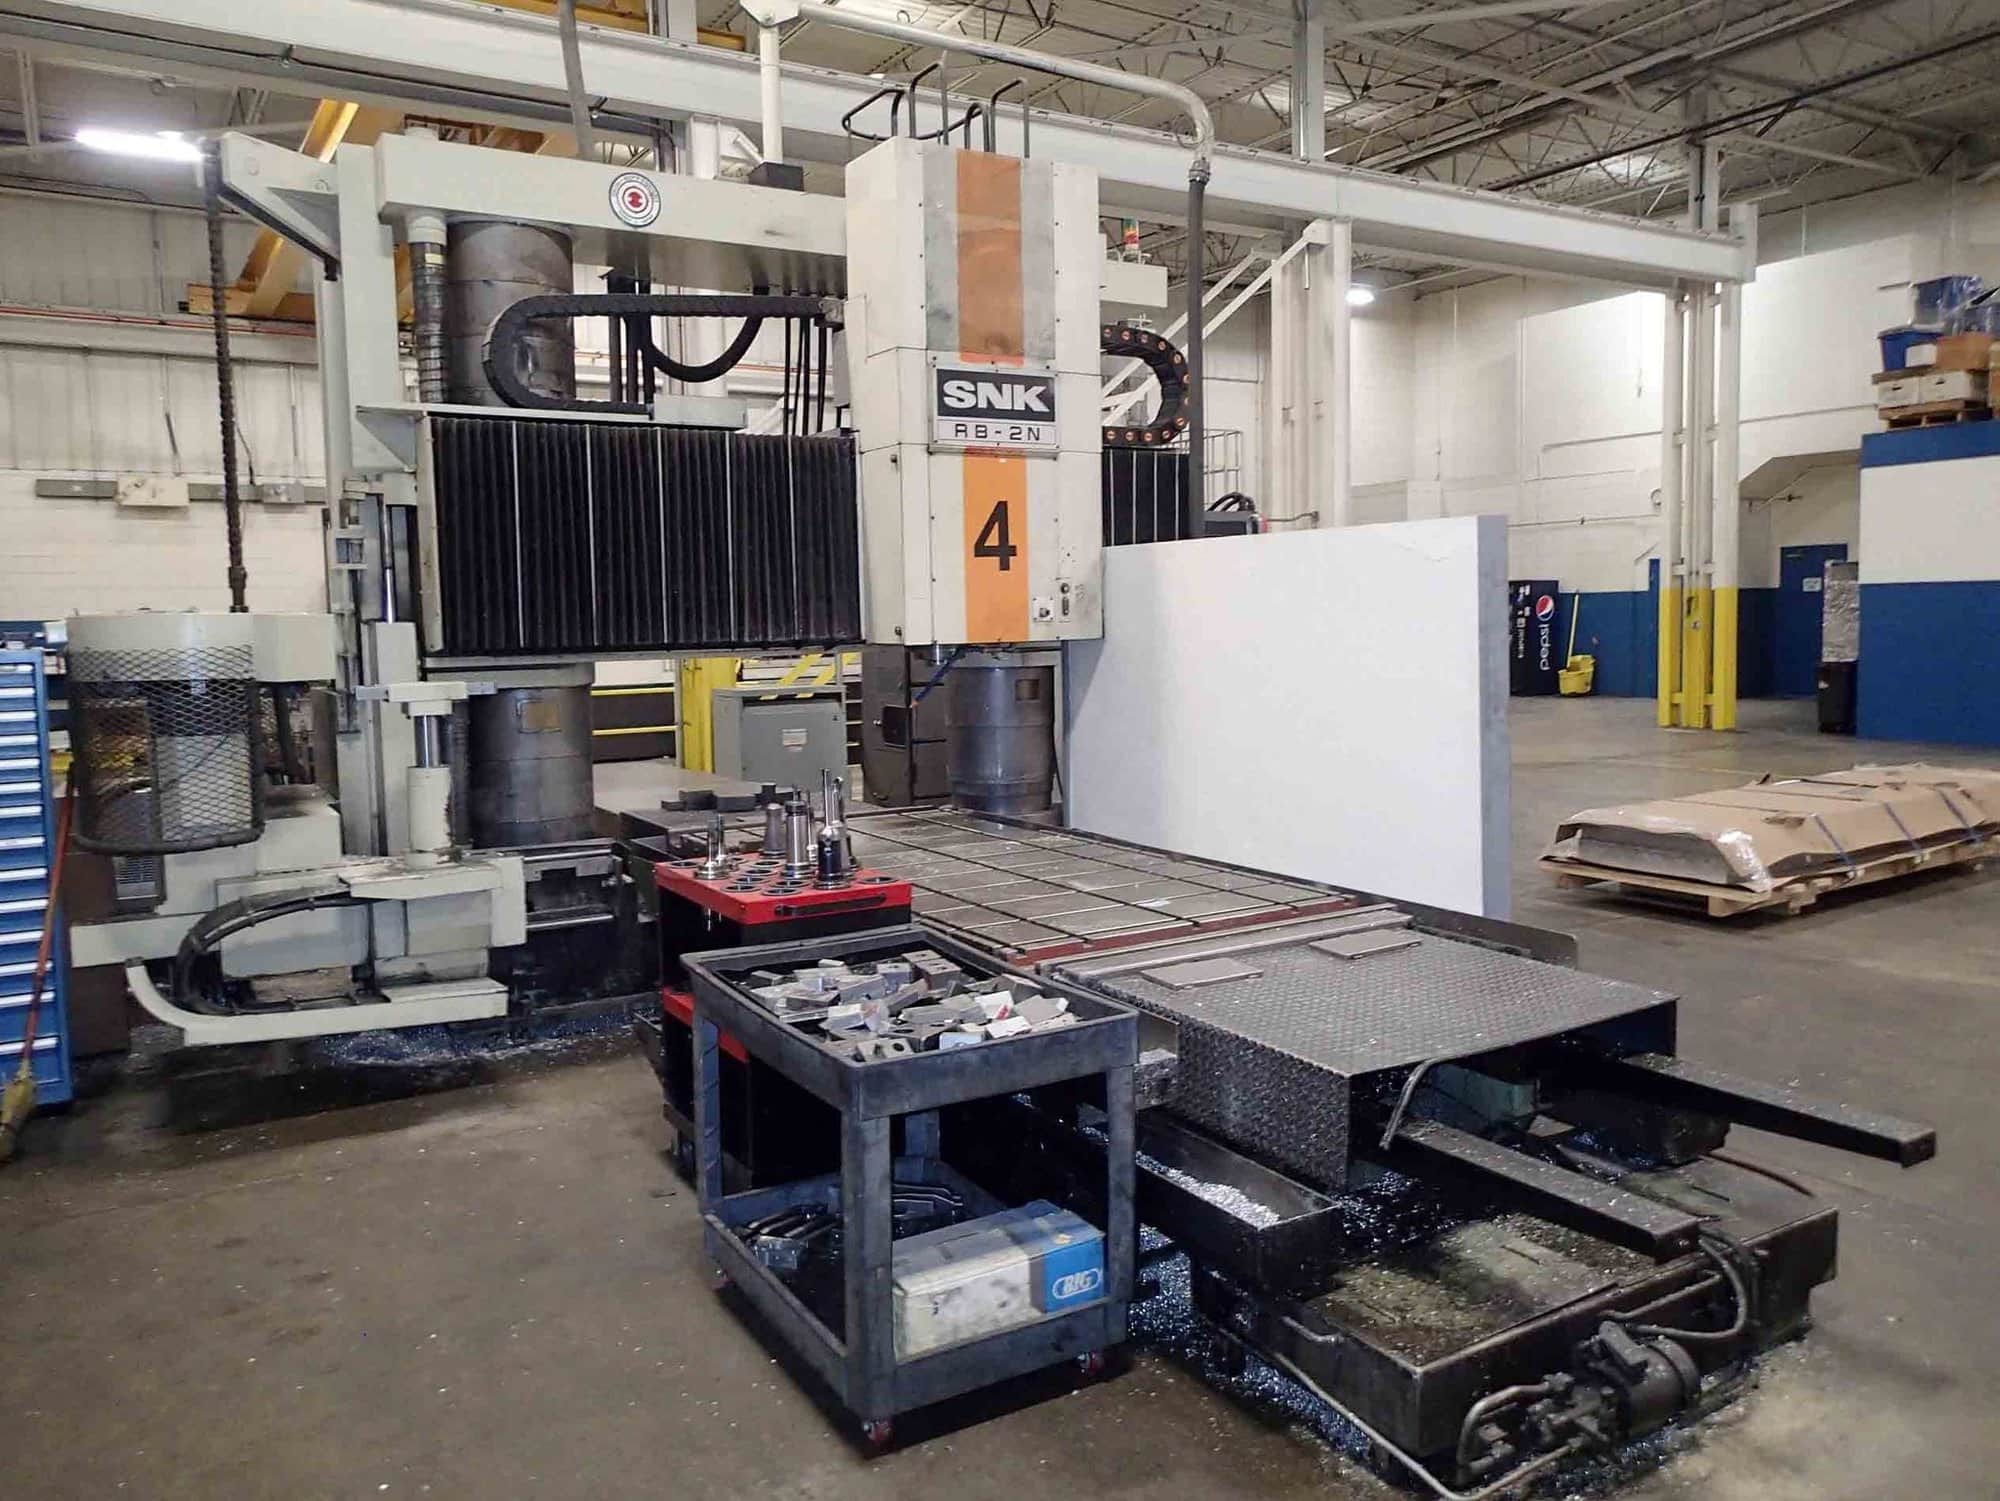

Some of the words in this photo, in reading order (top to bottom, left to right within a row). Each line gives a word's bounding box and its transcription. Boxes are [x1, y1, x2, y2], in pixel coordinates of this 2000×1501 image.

[943, 380, 1049, 412] SNK
[955, 424, 1040, 441] RB-2N
[973, 500, 1017, 571] 4
[1538, 624, 1551, 671] pepsi
